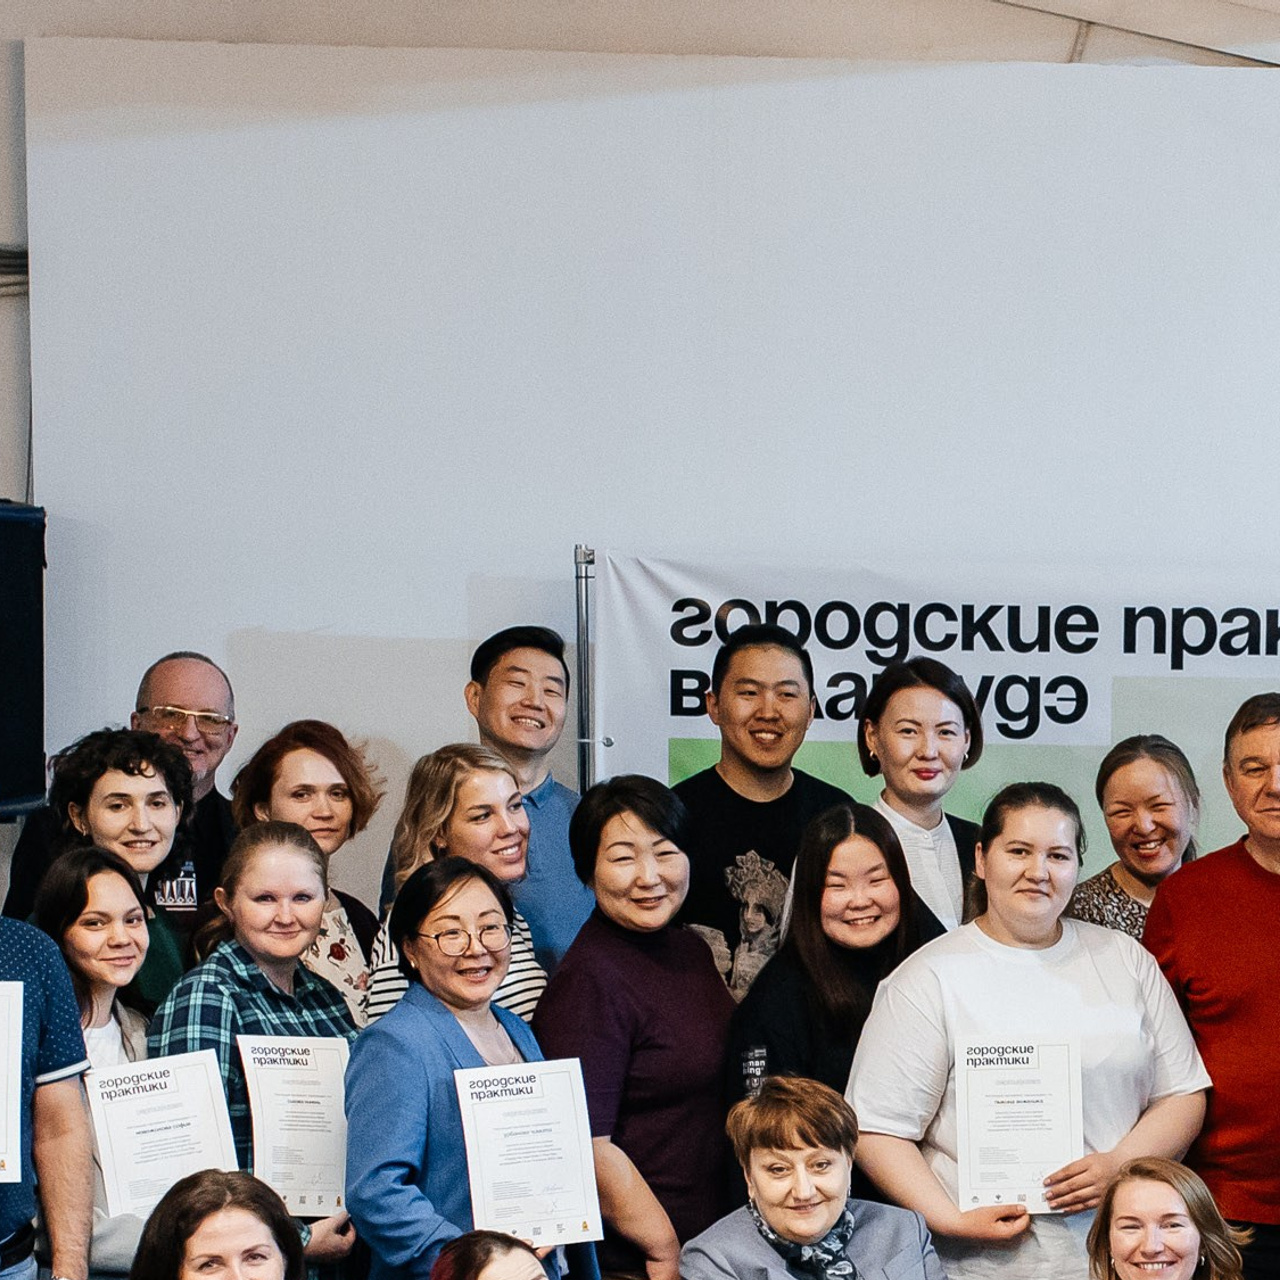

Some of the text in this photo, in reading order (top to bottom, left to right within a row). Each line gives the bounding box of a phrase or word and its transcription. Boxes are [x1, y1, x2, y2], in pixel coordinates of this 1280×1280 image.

[669, 597, 1100, 666] городские
[669, 668, 712, 717] в
[250, 1046, 311, 1058] городские
[966, 1045, 1034, 1056] городские
[252, 1056, 309, 1067] практики
[966, 1056, 1030, 1068] практики
[99, 1068, 171, 1090] городские
[469, 1073, 537, 1090] городские
[100, 1080, 168, 1102] практики
[470, 1085, 534, 1101] практики
